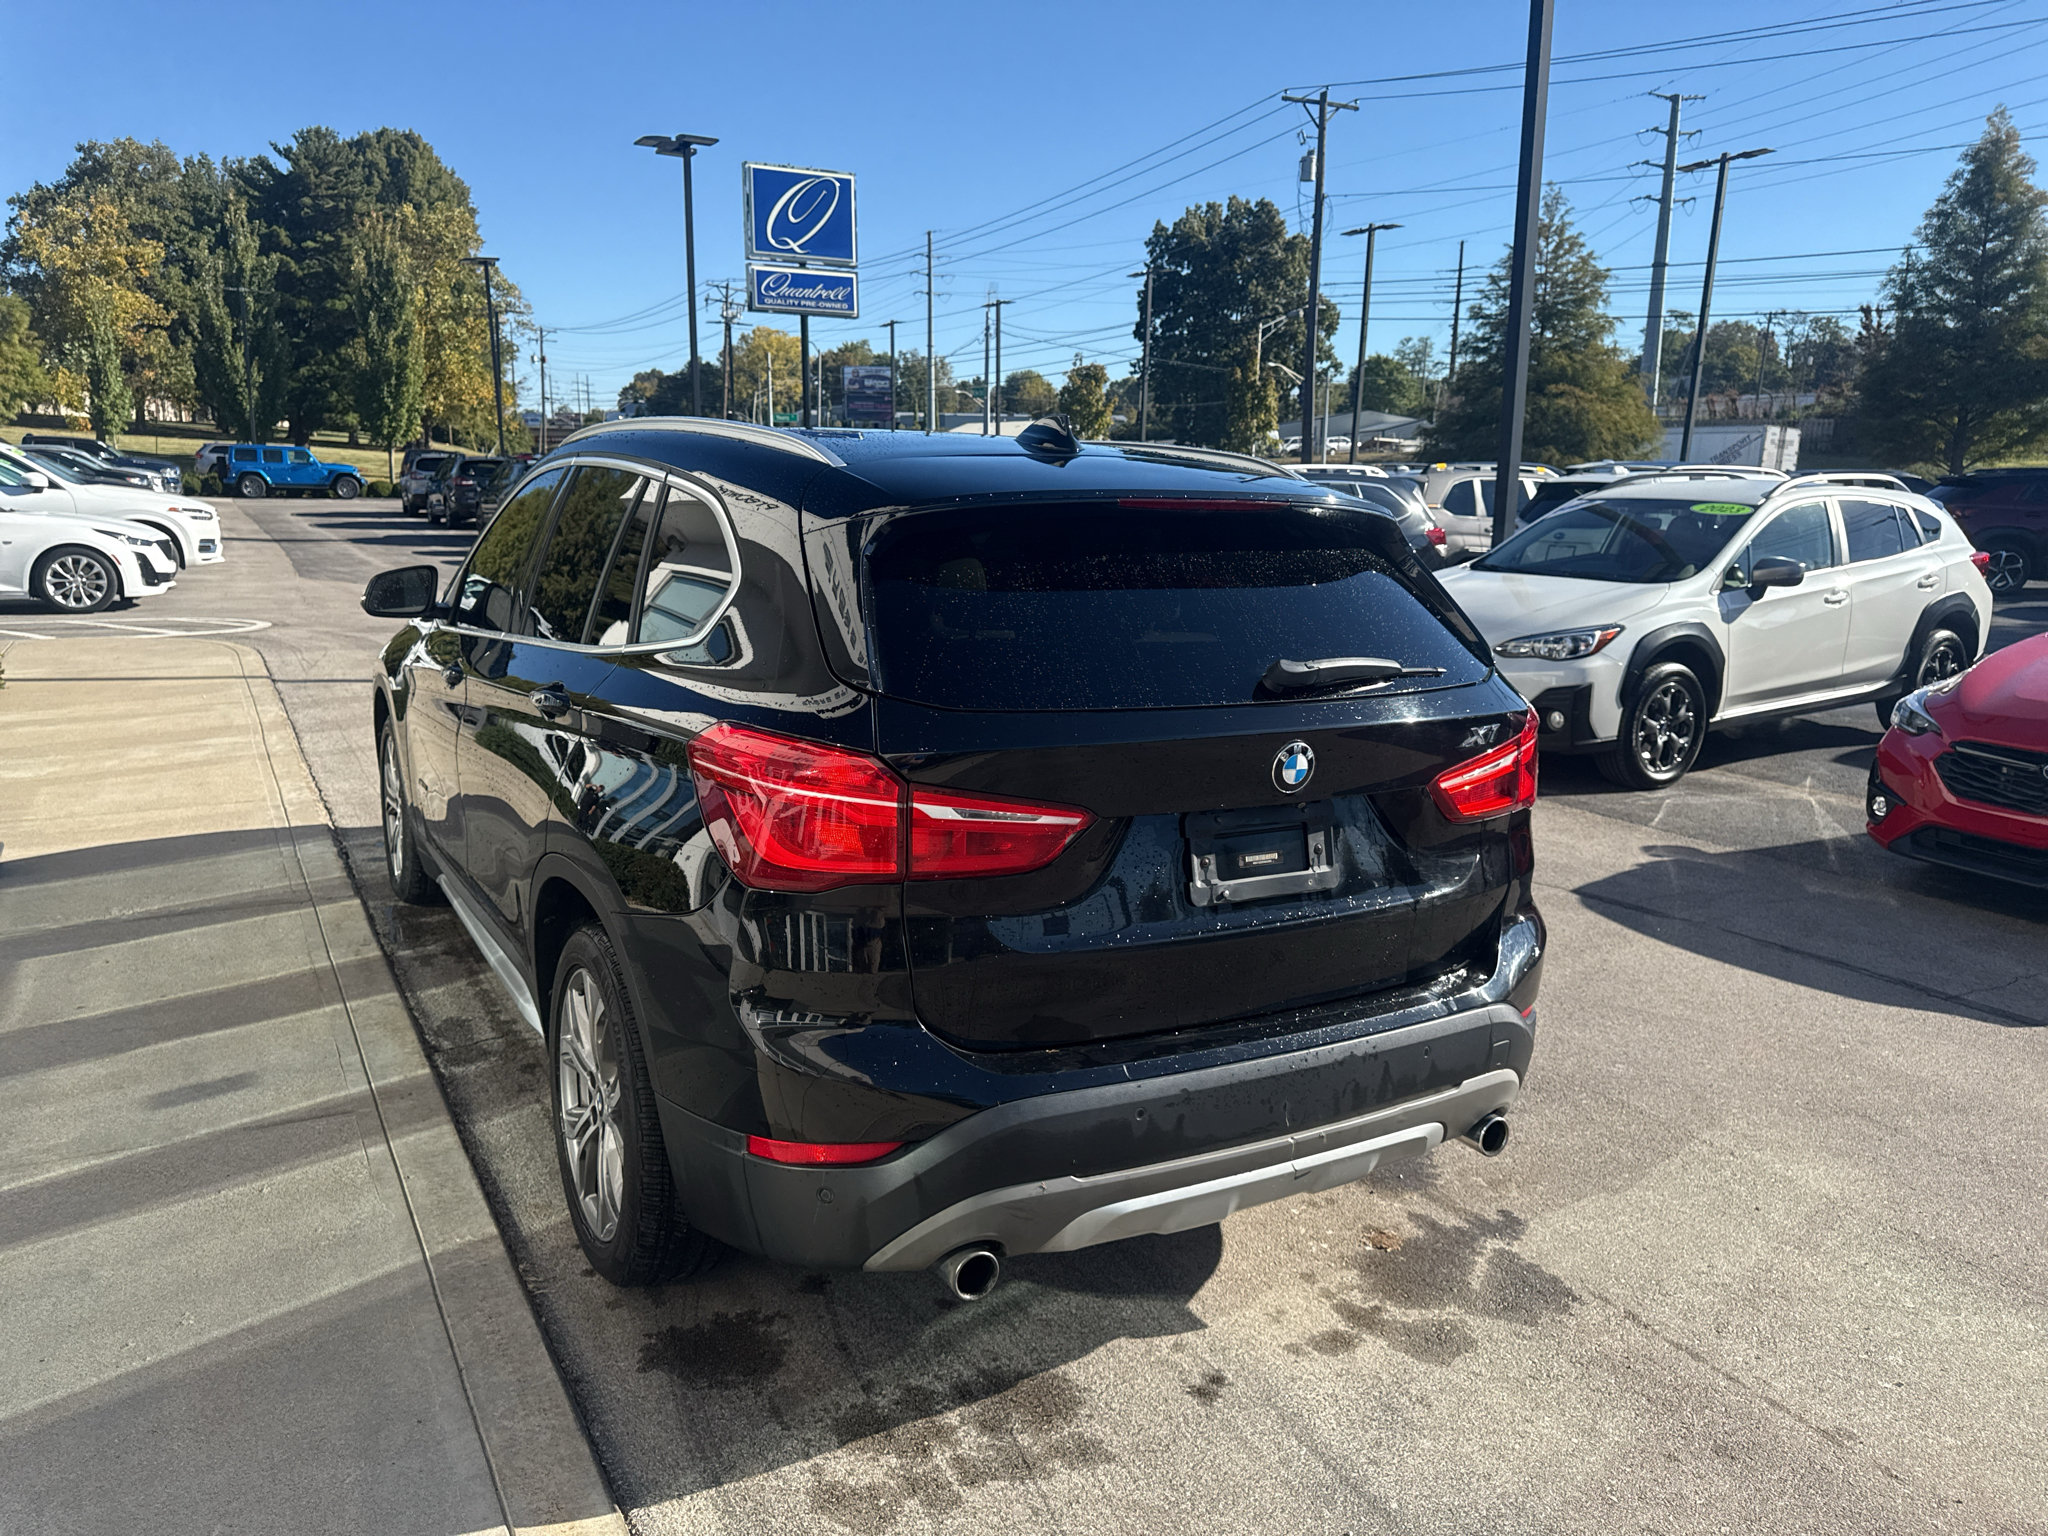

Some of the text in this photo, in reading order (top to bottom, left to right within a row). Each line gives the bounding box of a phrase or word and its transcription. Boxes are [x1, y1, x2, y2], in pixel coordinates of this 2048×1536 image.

[766, 177, 840, 254] Q
[761, 273, 851, 300] Quantrell
[764, 297, 848, 310] QUALITY PRE-OWNED
[1462, 723, 1501, 748] X1
